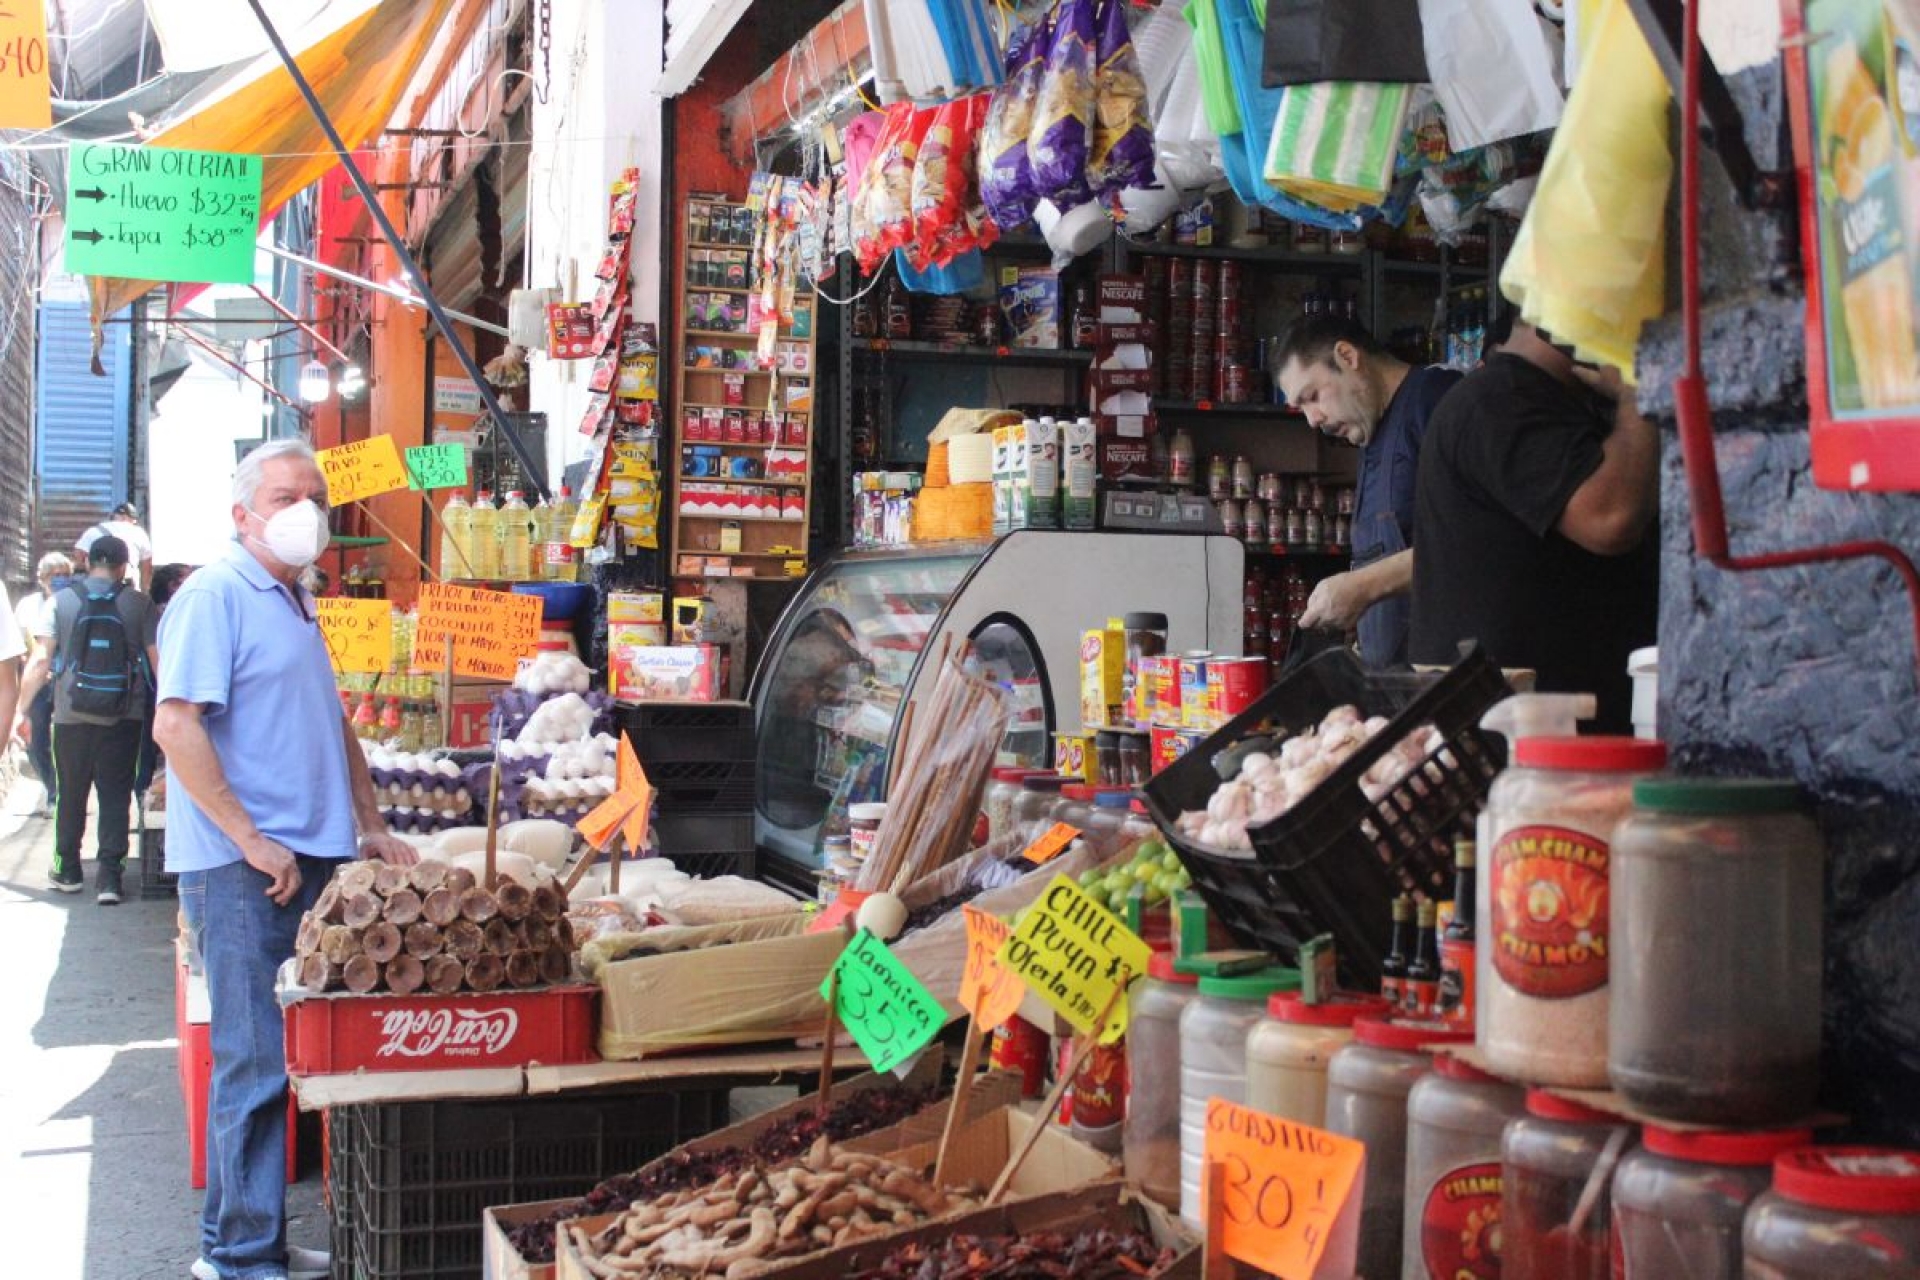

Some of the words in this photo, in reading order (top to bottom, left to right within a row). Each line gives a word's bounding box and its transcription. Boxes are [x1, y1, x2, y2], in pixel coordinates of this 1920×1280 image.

[82, 145, 151, 177] GRAN
[120, 181, 178, 213] Huevo
[116, 222, 162, 254] Tapa
[182, 223, 226, 251] $58
[409, 446, 451, 459] ACEITE
[1046, 885, 1129, 956] CHILE
[852, 929, 931, 1030] Jamaica
[1009, 936, 1070, 999] Oferta
